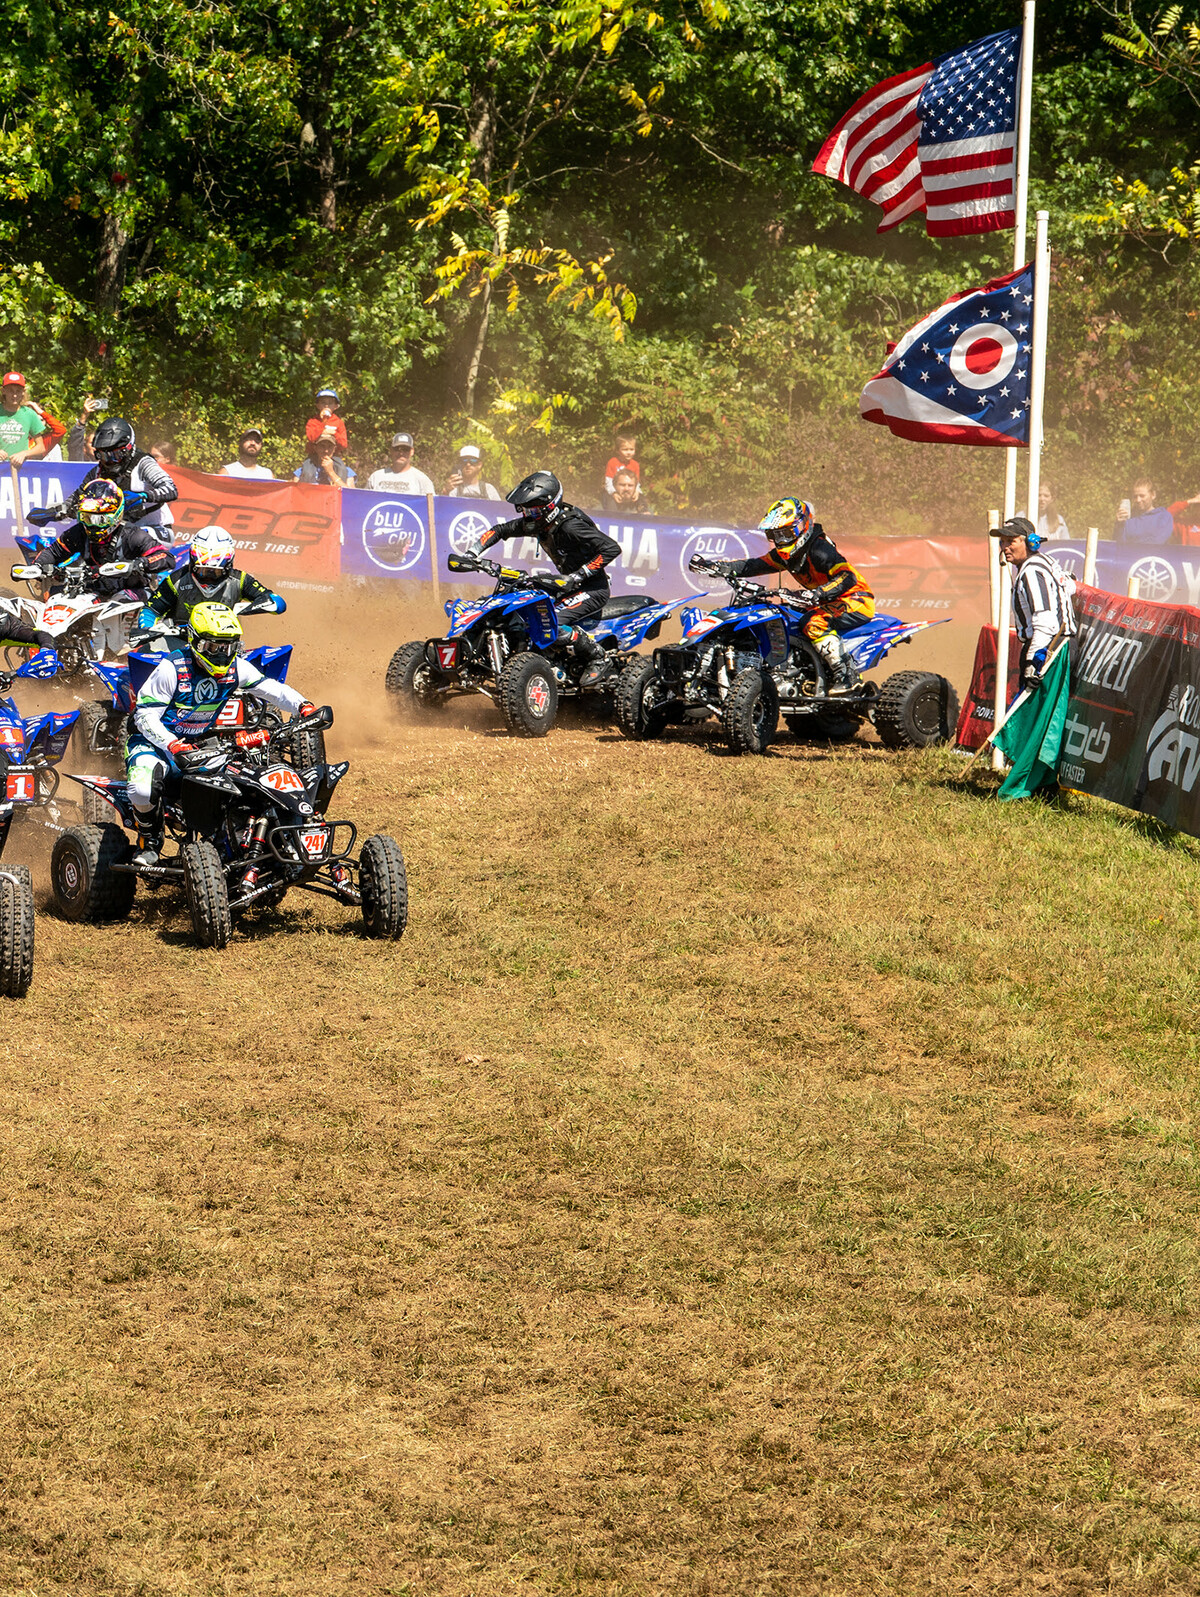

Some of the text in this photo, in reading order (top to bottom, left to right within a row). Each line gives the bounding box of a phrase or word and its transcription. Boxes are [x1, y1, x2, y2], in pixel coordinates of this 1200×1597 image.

[374, 511, 404, 528] bLU
[264, 542, 301, 556] TIRES
[694, 536, 728, 554] bLU
[442, 648, 456, 665] 7
[218, 701, 240, 721] 9
[4, 729, 16, 743] 1
[267, 770, 304, 791] 241
[304, 835, 325, 854] 241
